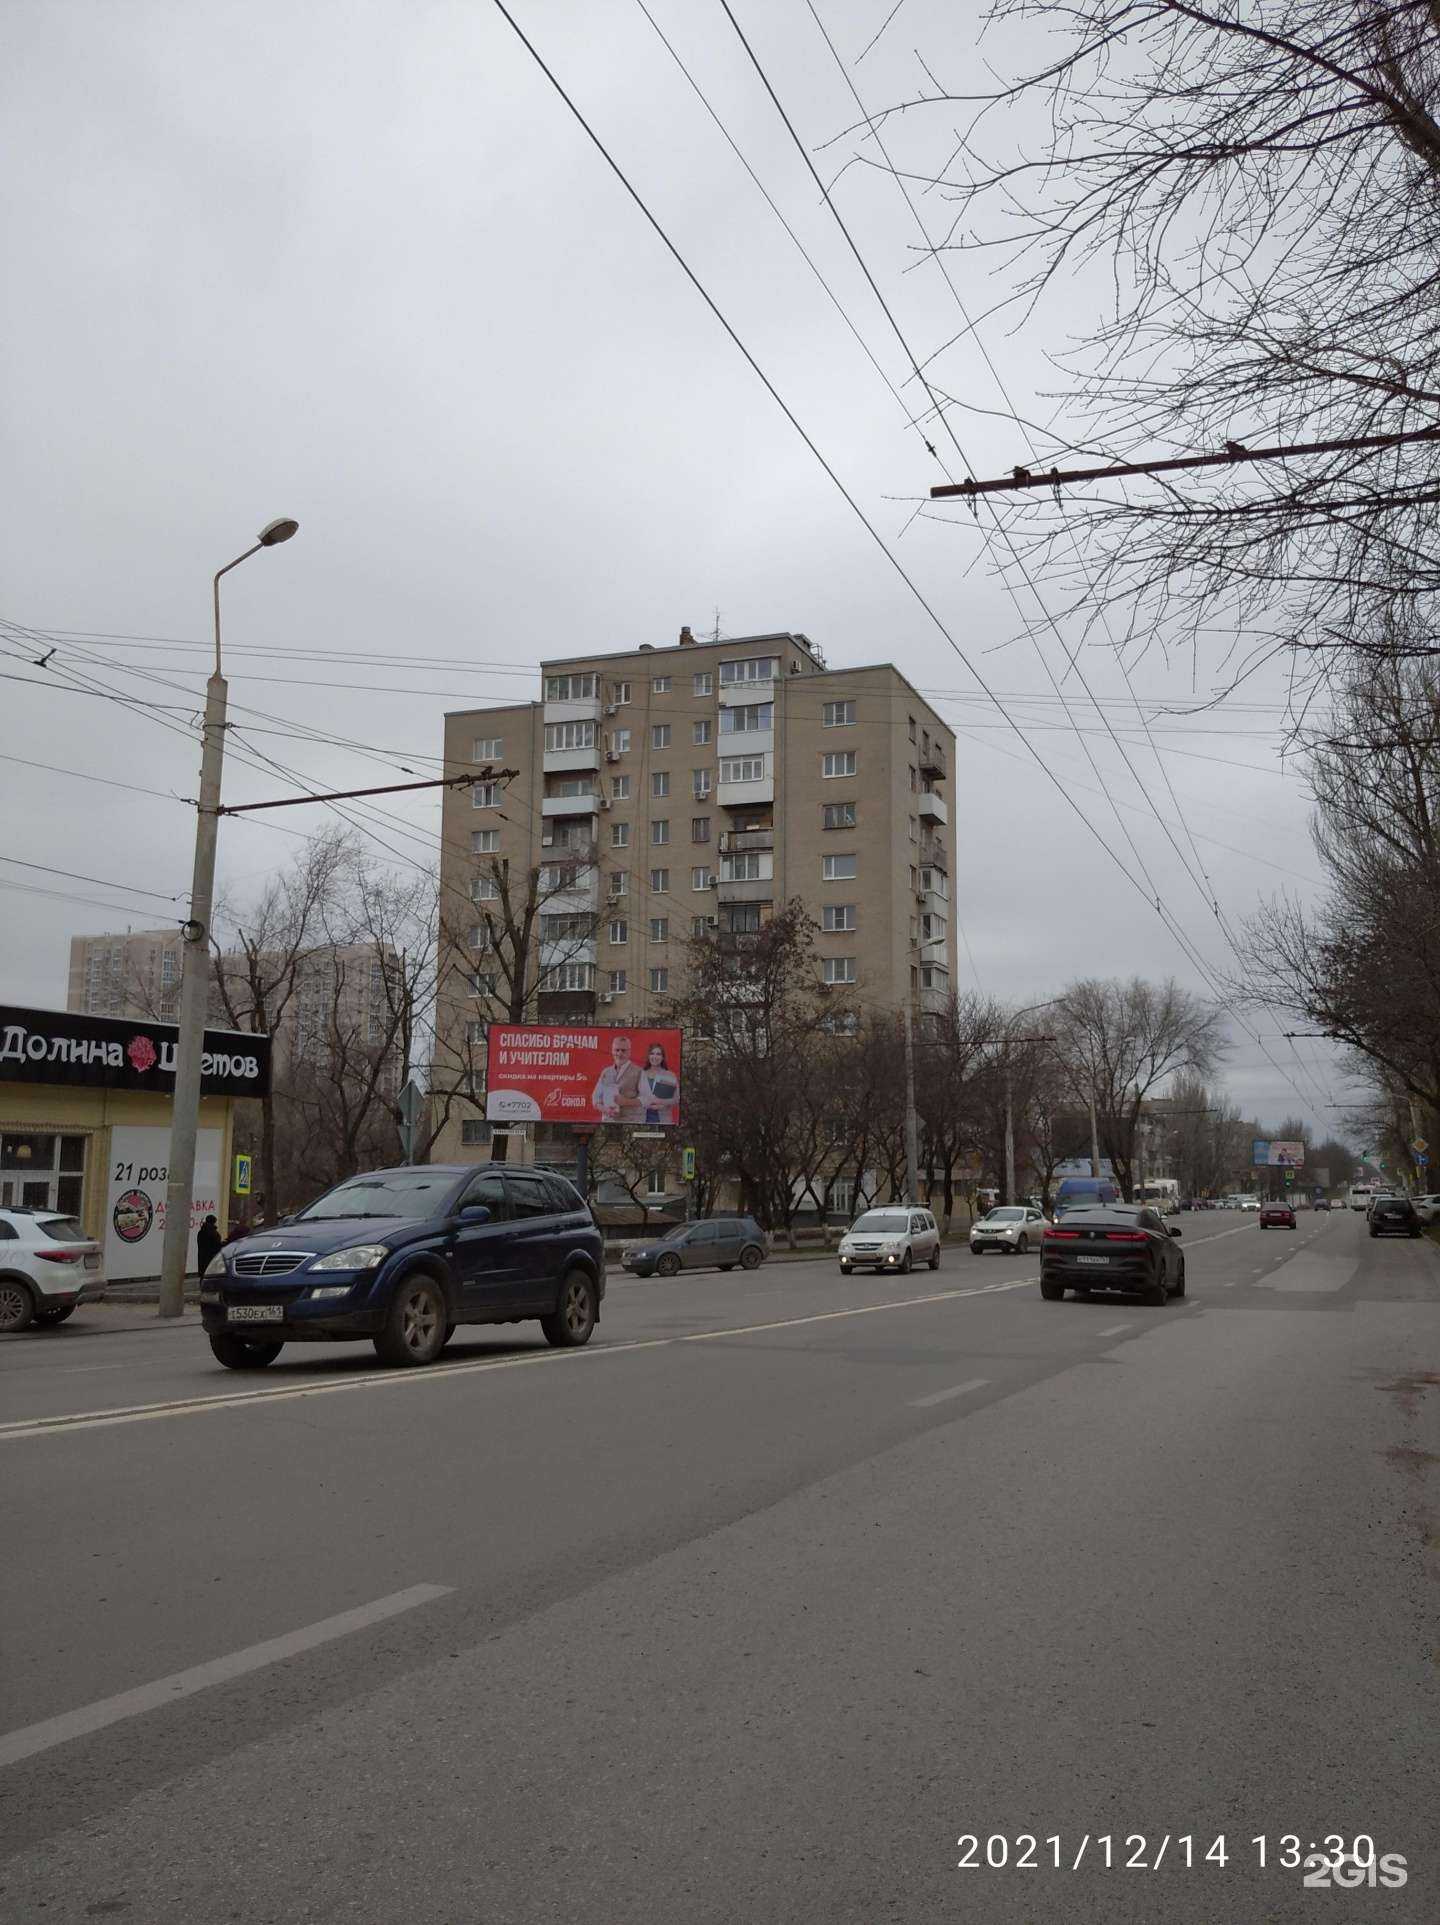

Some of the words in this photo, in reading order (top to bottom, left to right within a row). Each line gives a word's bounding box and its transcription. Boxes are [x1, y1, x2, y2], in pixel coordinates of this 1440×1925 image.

[500, 1033, 550, 1048] СПАСИБО
[553, 1034, 598, 1049] ВРАЧАМ
[0, 1025, 124, 1067] Долина
[158, 1041, 259, 1078] Цетов
[499, 1050, 508, 1064] И
[511, 1051, 570, 1066] УЧИТЕЛЯМ
[114, 1162, 134, 1181] 21
